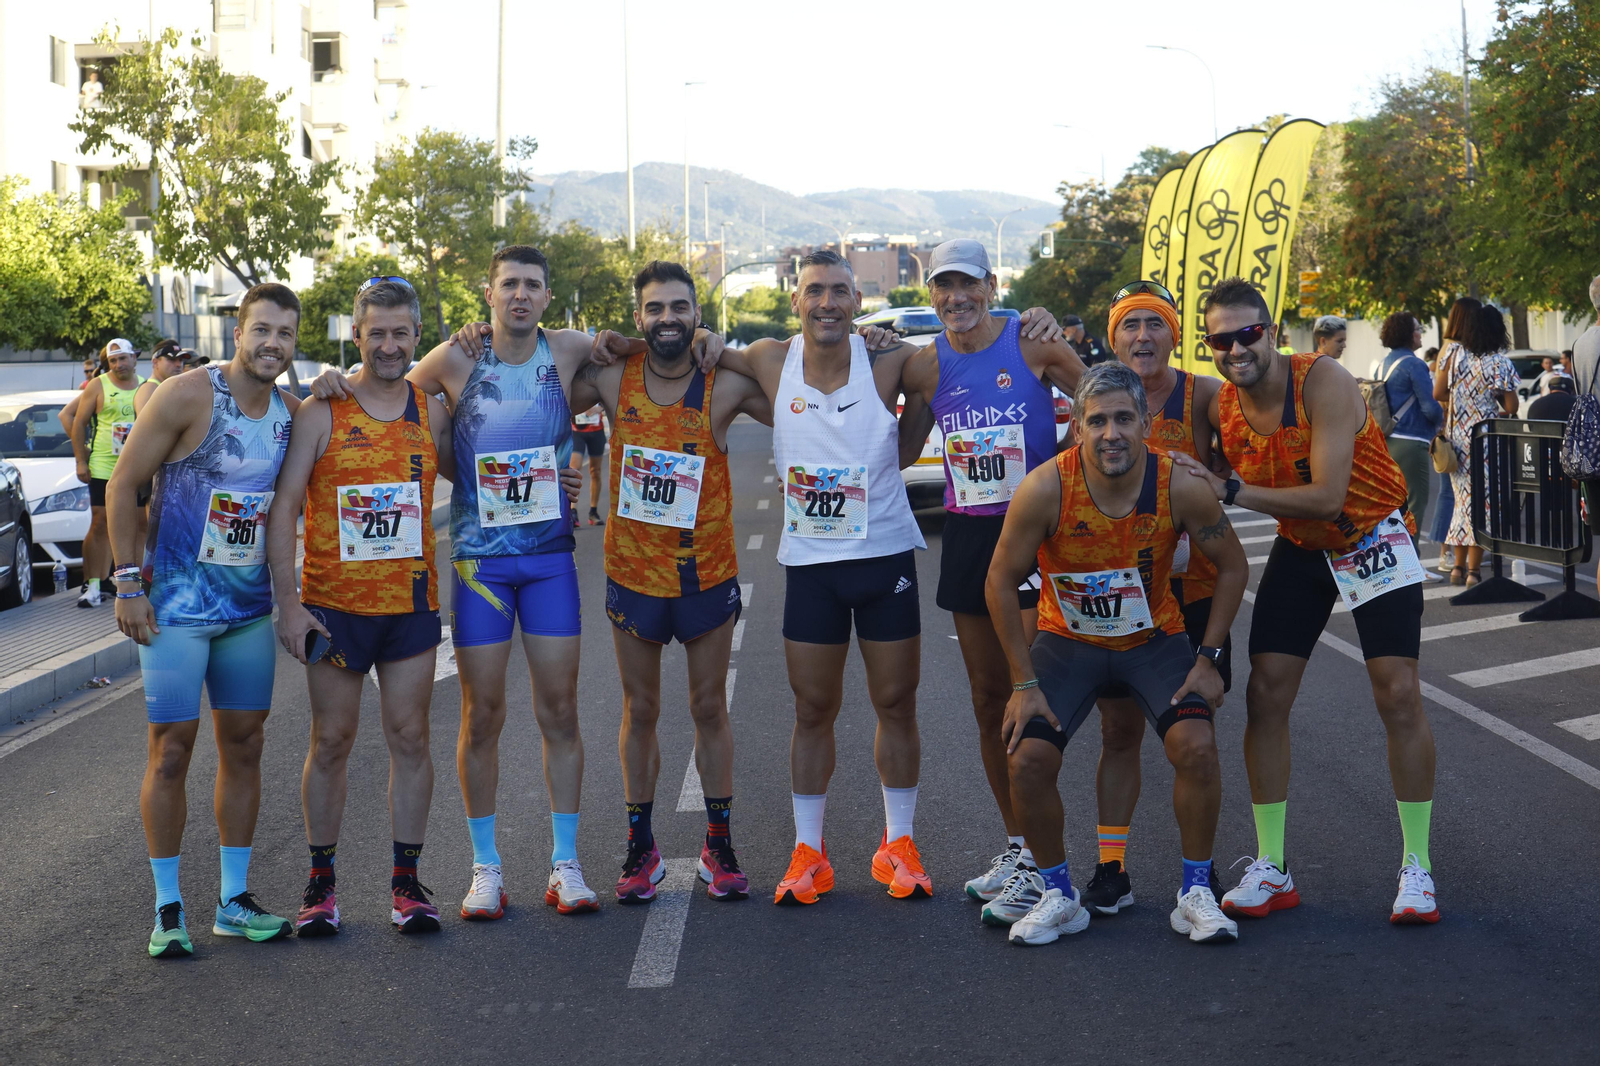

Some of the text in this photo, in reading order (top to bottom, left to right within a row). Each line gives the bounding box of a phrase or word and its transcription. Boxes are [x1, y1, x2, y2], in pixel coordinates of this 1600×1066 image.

[942, 402, 1028, 434] FILÍPIDES
[968, 454, 1005, 483] 490
[506, 476, 533, 504] 47
[642, 475, 677, 505] 130
[805, 491, 846, 518] 282
[227, 518, 257, 545] 361
[362, 511, 402, 538] 257
[1353, 541, 1398, 580] 323
[894, 581, 912, 594] adidas
[1081, 593, 1123, 618] 407
